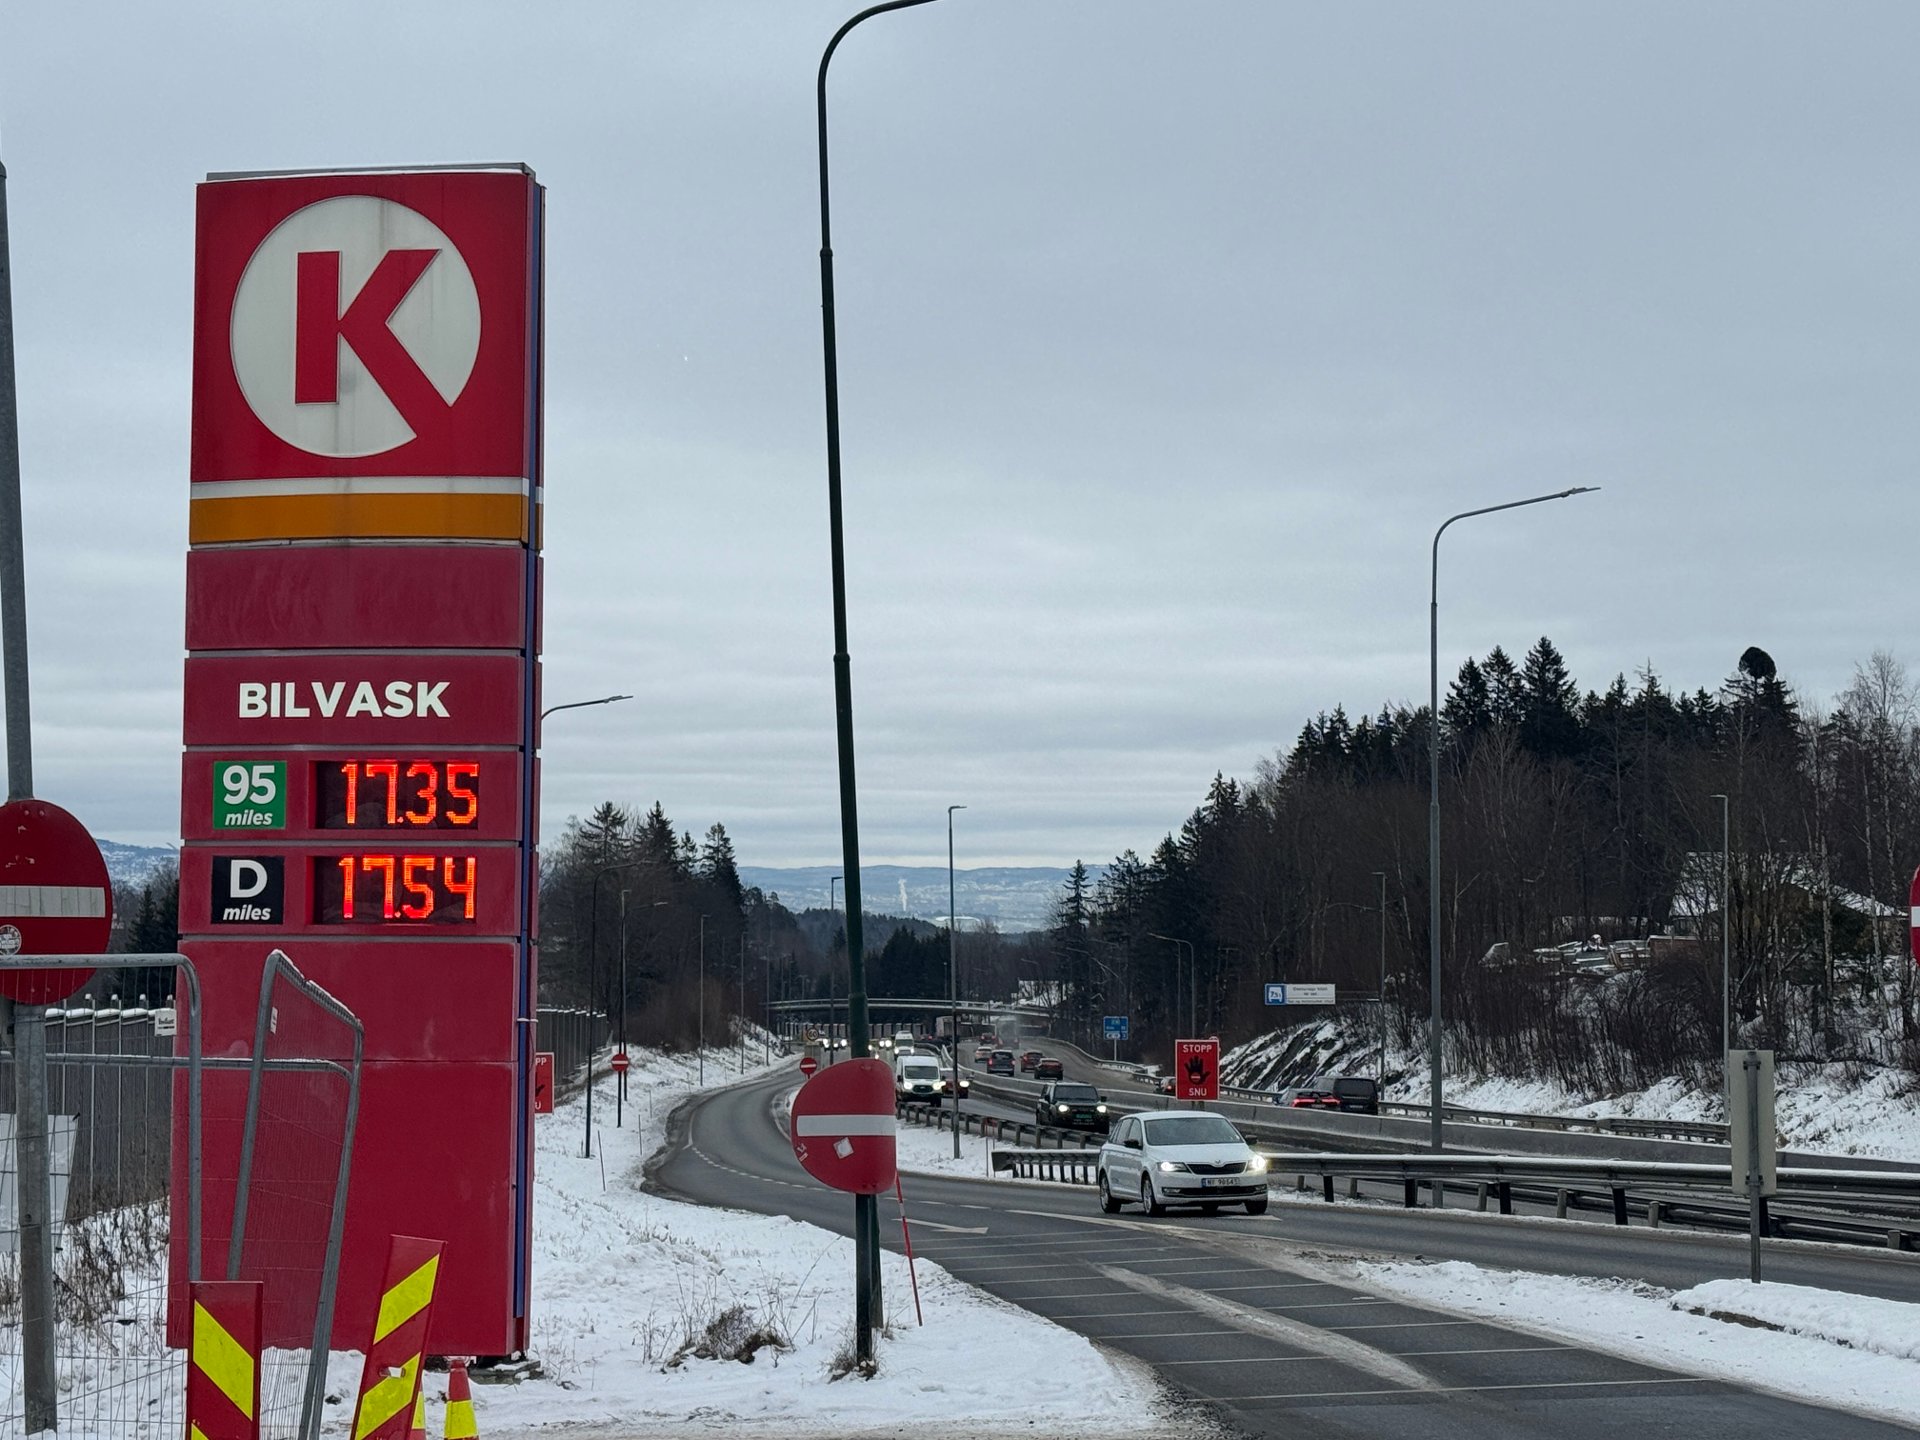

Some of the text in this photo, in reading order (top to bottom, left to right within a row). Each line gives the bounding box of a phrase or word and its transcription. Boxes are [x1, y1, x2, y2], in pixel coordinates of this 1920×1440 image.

[295, 248, 453, 437] K
[238, 681, 451, 718] BILVASK
[222, 764, 277, 805] 95
[341, 763, 479, 824] 17.35
[224, 810, 273, 826] miles
[229, 859, 268, 898] D
[338, 856, 476, 919] 17.54
[222, 905, 272, 921] miles
[1182, 1044, 1212, 1053] STOPP
[1188, 1087, 1207, 1097] SNU
